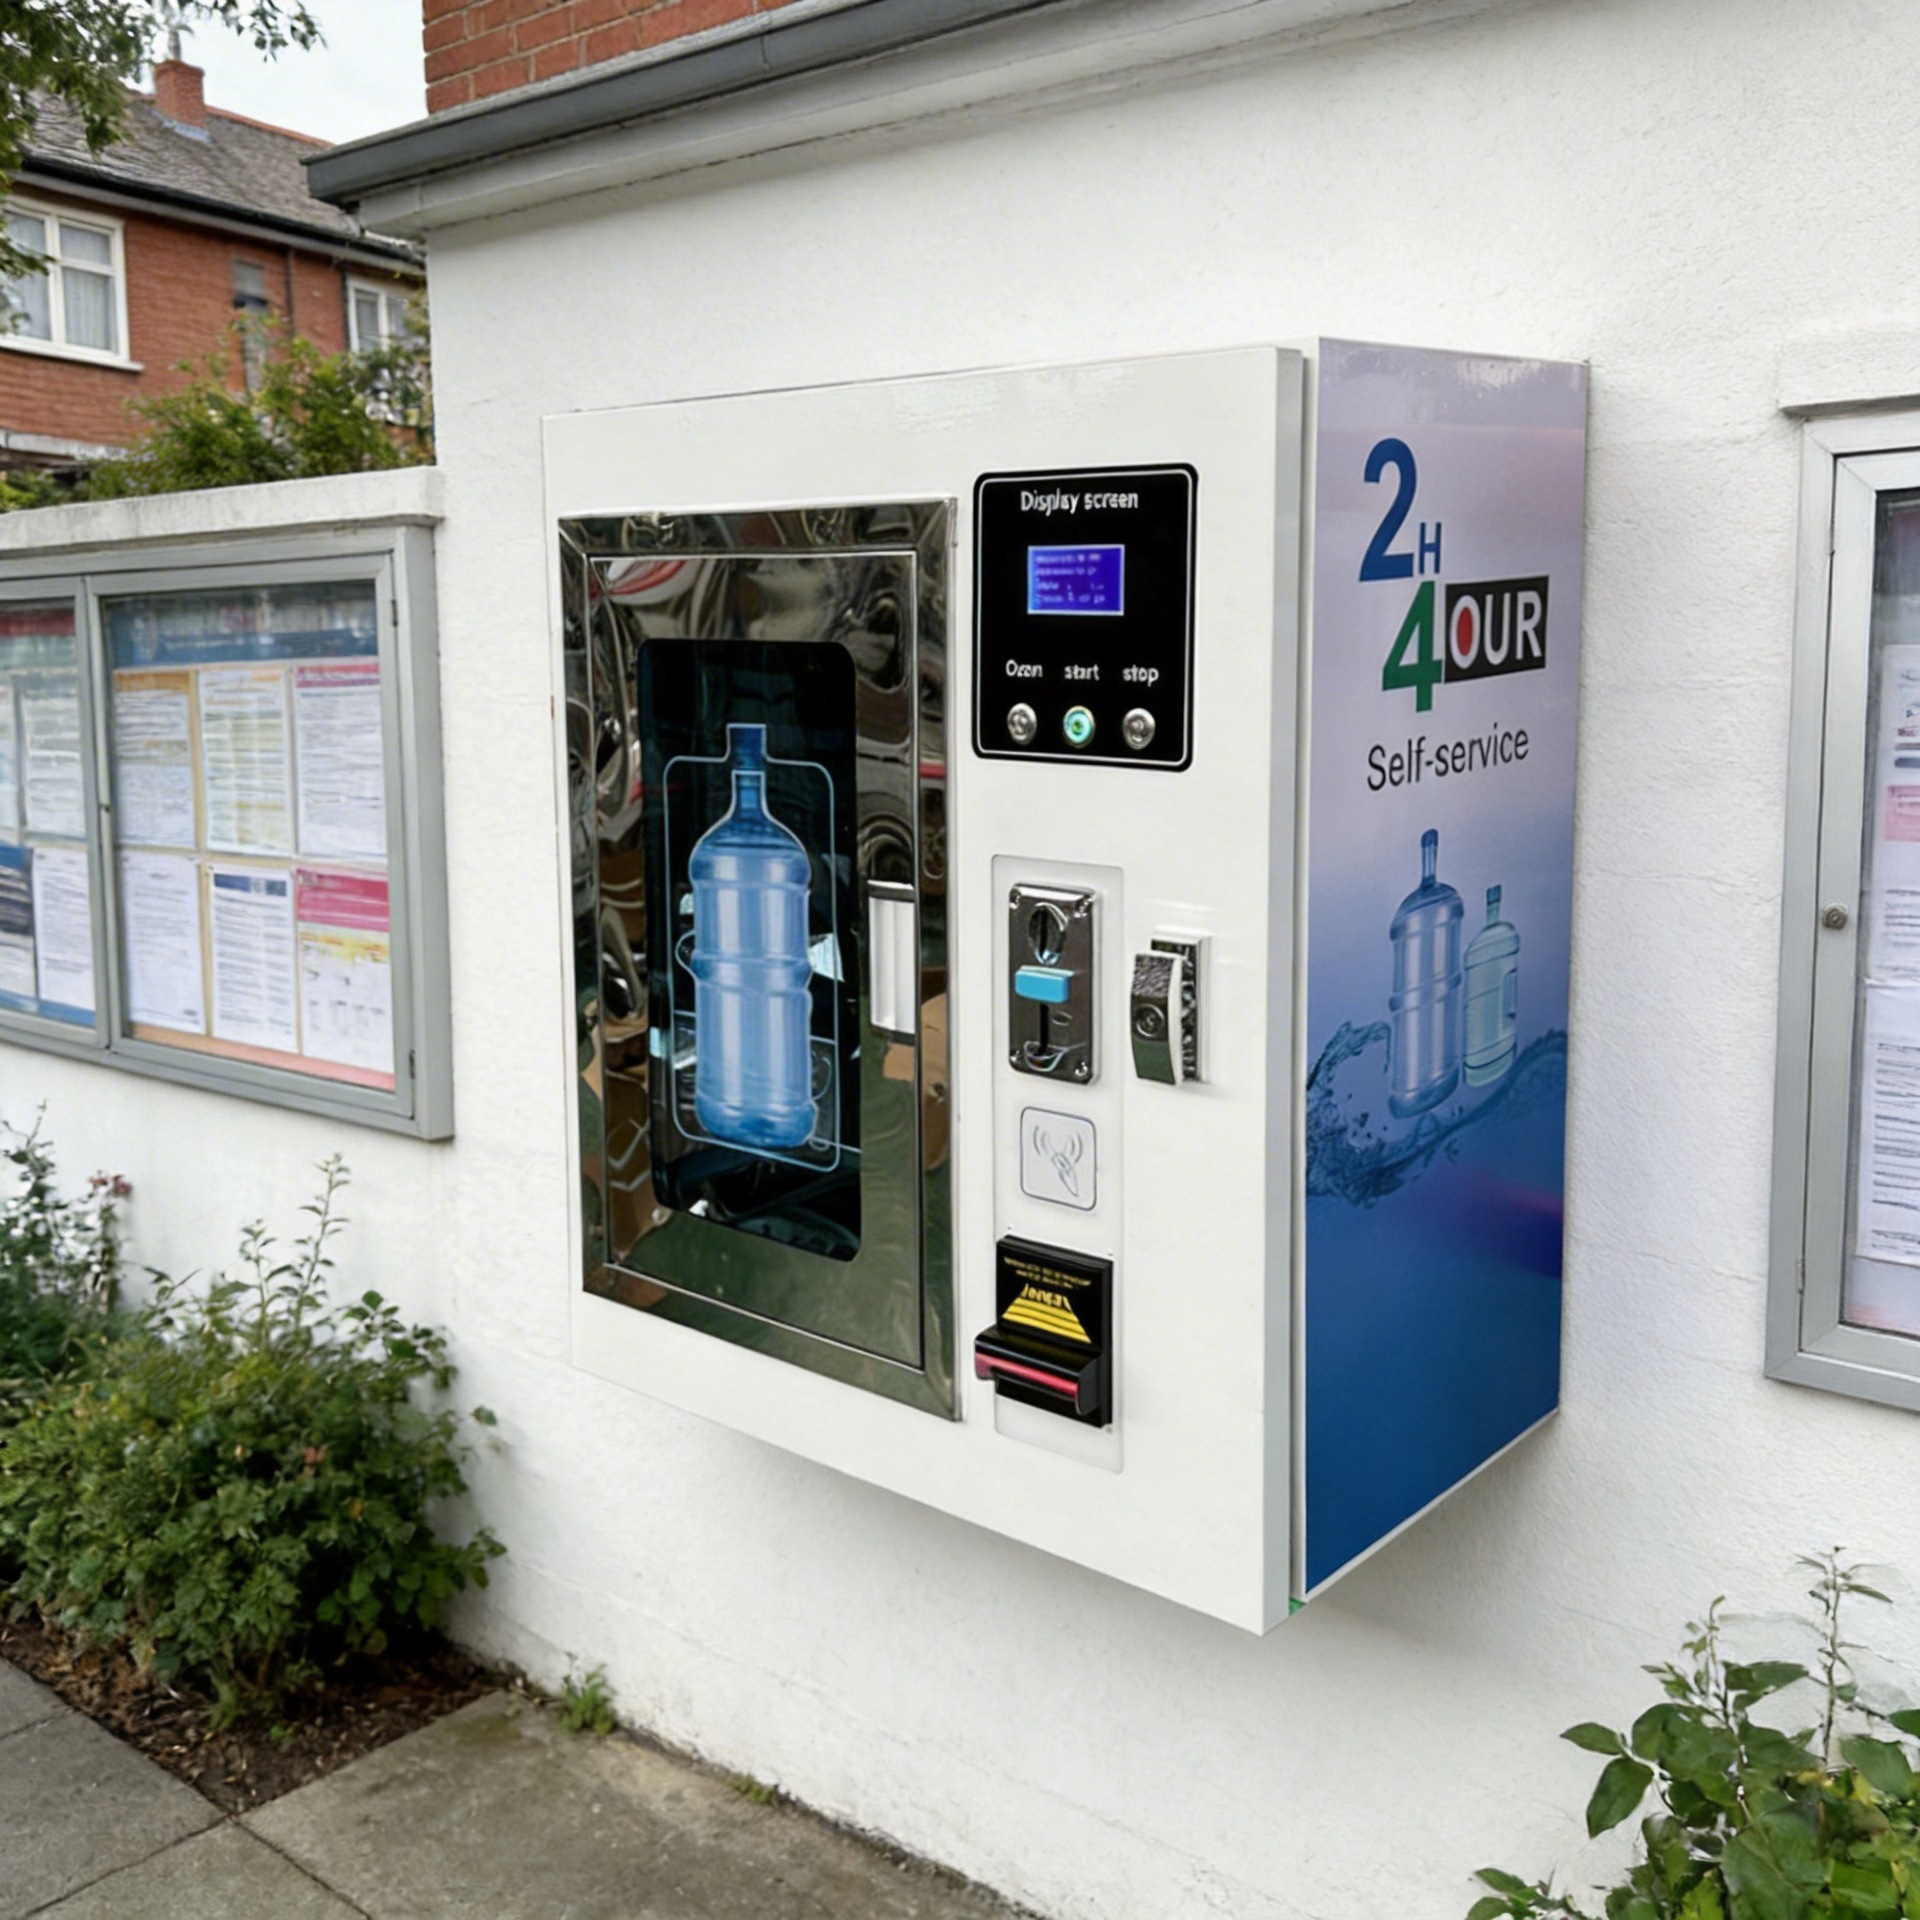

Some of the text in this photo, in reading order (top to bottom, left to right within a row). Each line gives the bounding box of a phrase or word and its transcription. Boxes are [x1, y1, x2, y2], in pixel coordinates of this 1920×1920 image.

[1021, 488, 1139, 516] Display screen
[1064, 664, 1100, 681] start
[1122, 664, 1159, 687] stop
[1367, 722, 1529, 791] Self-service
